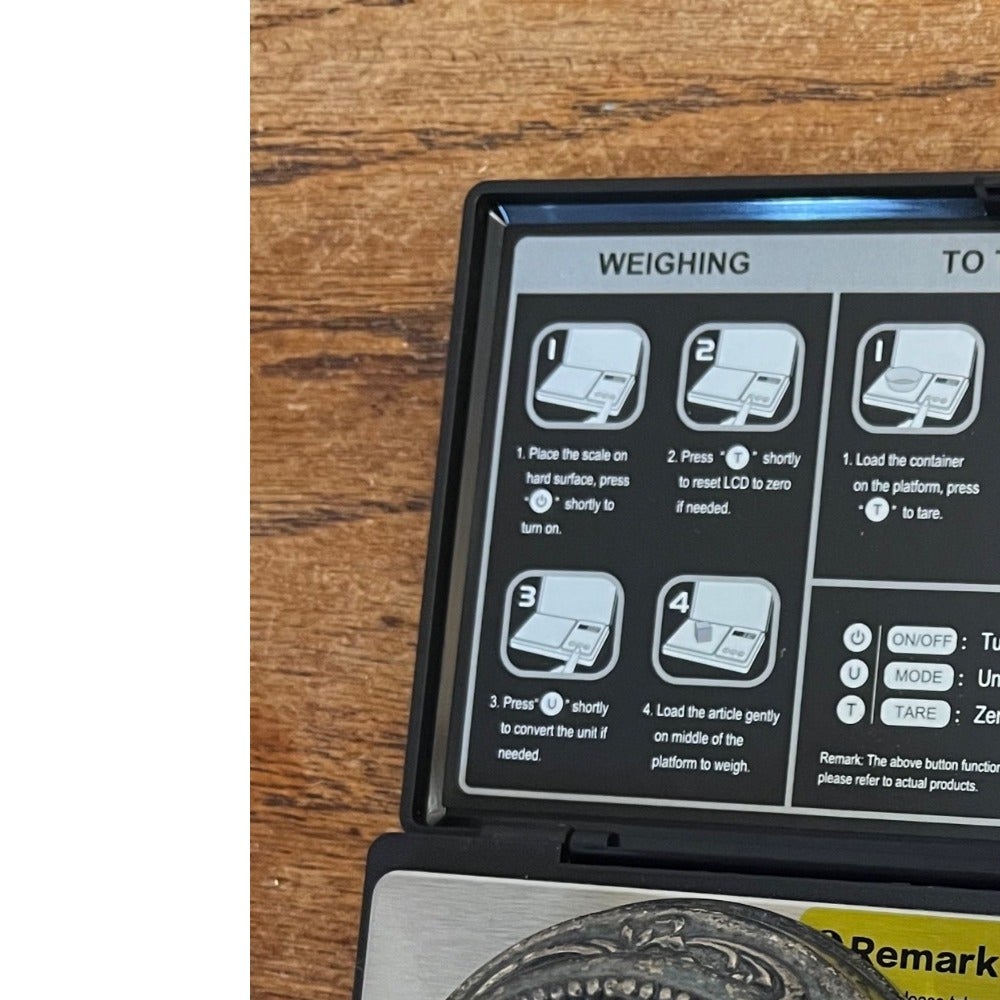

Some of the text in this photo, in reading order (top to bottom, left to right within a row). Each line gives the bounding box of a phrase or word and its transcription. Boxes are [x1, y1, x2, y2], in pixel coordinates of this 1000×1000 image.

[600, 252, 750, 275] WEIGHING
[943, 250, 984, 274] TO
[695, 339, 715, 361] 2
[529, 447, 559, 460] Place
[562, 448, 579, 460] the
[582, 449, 611, 461] scale
[614, 452, 628, 461] on
[681, 451, 713, 464] Press
[763, 452, 801, 468] shortly
[856, 454, 886, 467] Load
[889, 454, 906, 467] the
[909, 455, 964, 468] container
[527, 472, 630, 488] hard surface, press
[679, 477, 791, 490] to reset LCD to zero
[853, 480, 980, 496] on the platform, press
[565, 498, 614, 513] shortly to
[676, 501, 731, 515] if needed.
[902, 506, 943, 520] to tare.
[521, 522, 562, 534] turn on.
[518, 585, 536, 607] 3
[669, 592, 689, 613] 4
[892, 633, 952, 647] ON/OFF
[895, 670, 943, 683] MODE
[572, 701, 608, 716] shortly
[657, 704, 685, 718] Load
[688, 706, 706, 719] the
[708, 707, 742, 720] article
[745, 709, 780, 725] gently
[895, 706, 936, 720] TARE
[501, 722, 607, 739] to convert the unit if
[654, 731, 743, 746] on middle of the
[498, 748, 541, 761] needed.
[820, 752, 863, 766] Remark:
[867, 754, 887, 767] The
[890, 756, 922, 769] above
[925, 757, 958, 770] button
[652, 756, 750, 776] platform to weigh.
[817, 773, 978, 792] please refer to actual products.
[851, 936, 1000, 977] Remark
